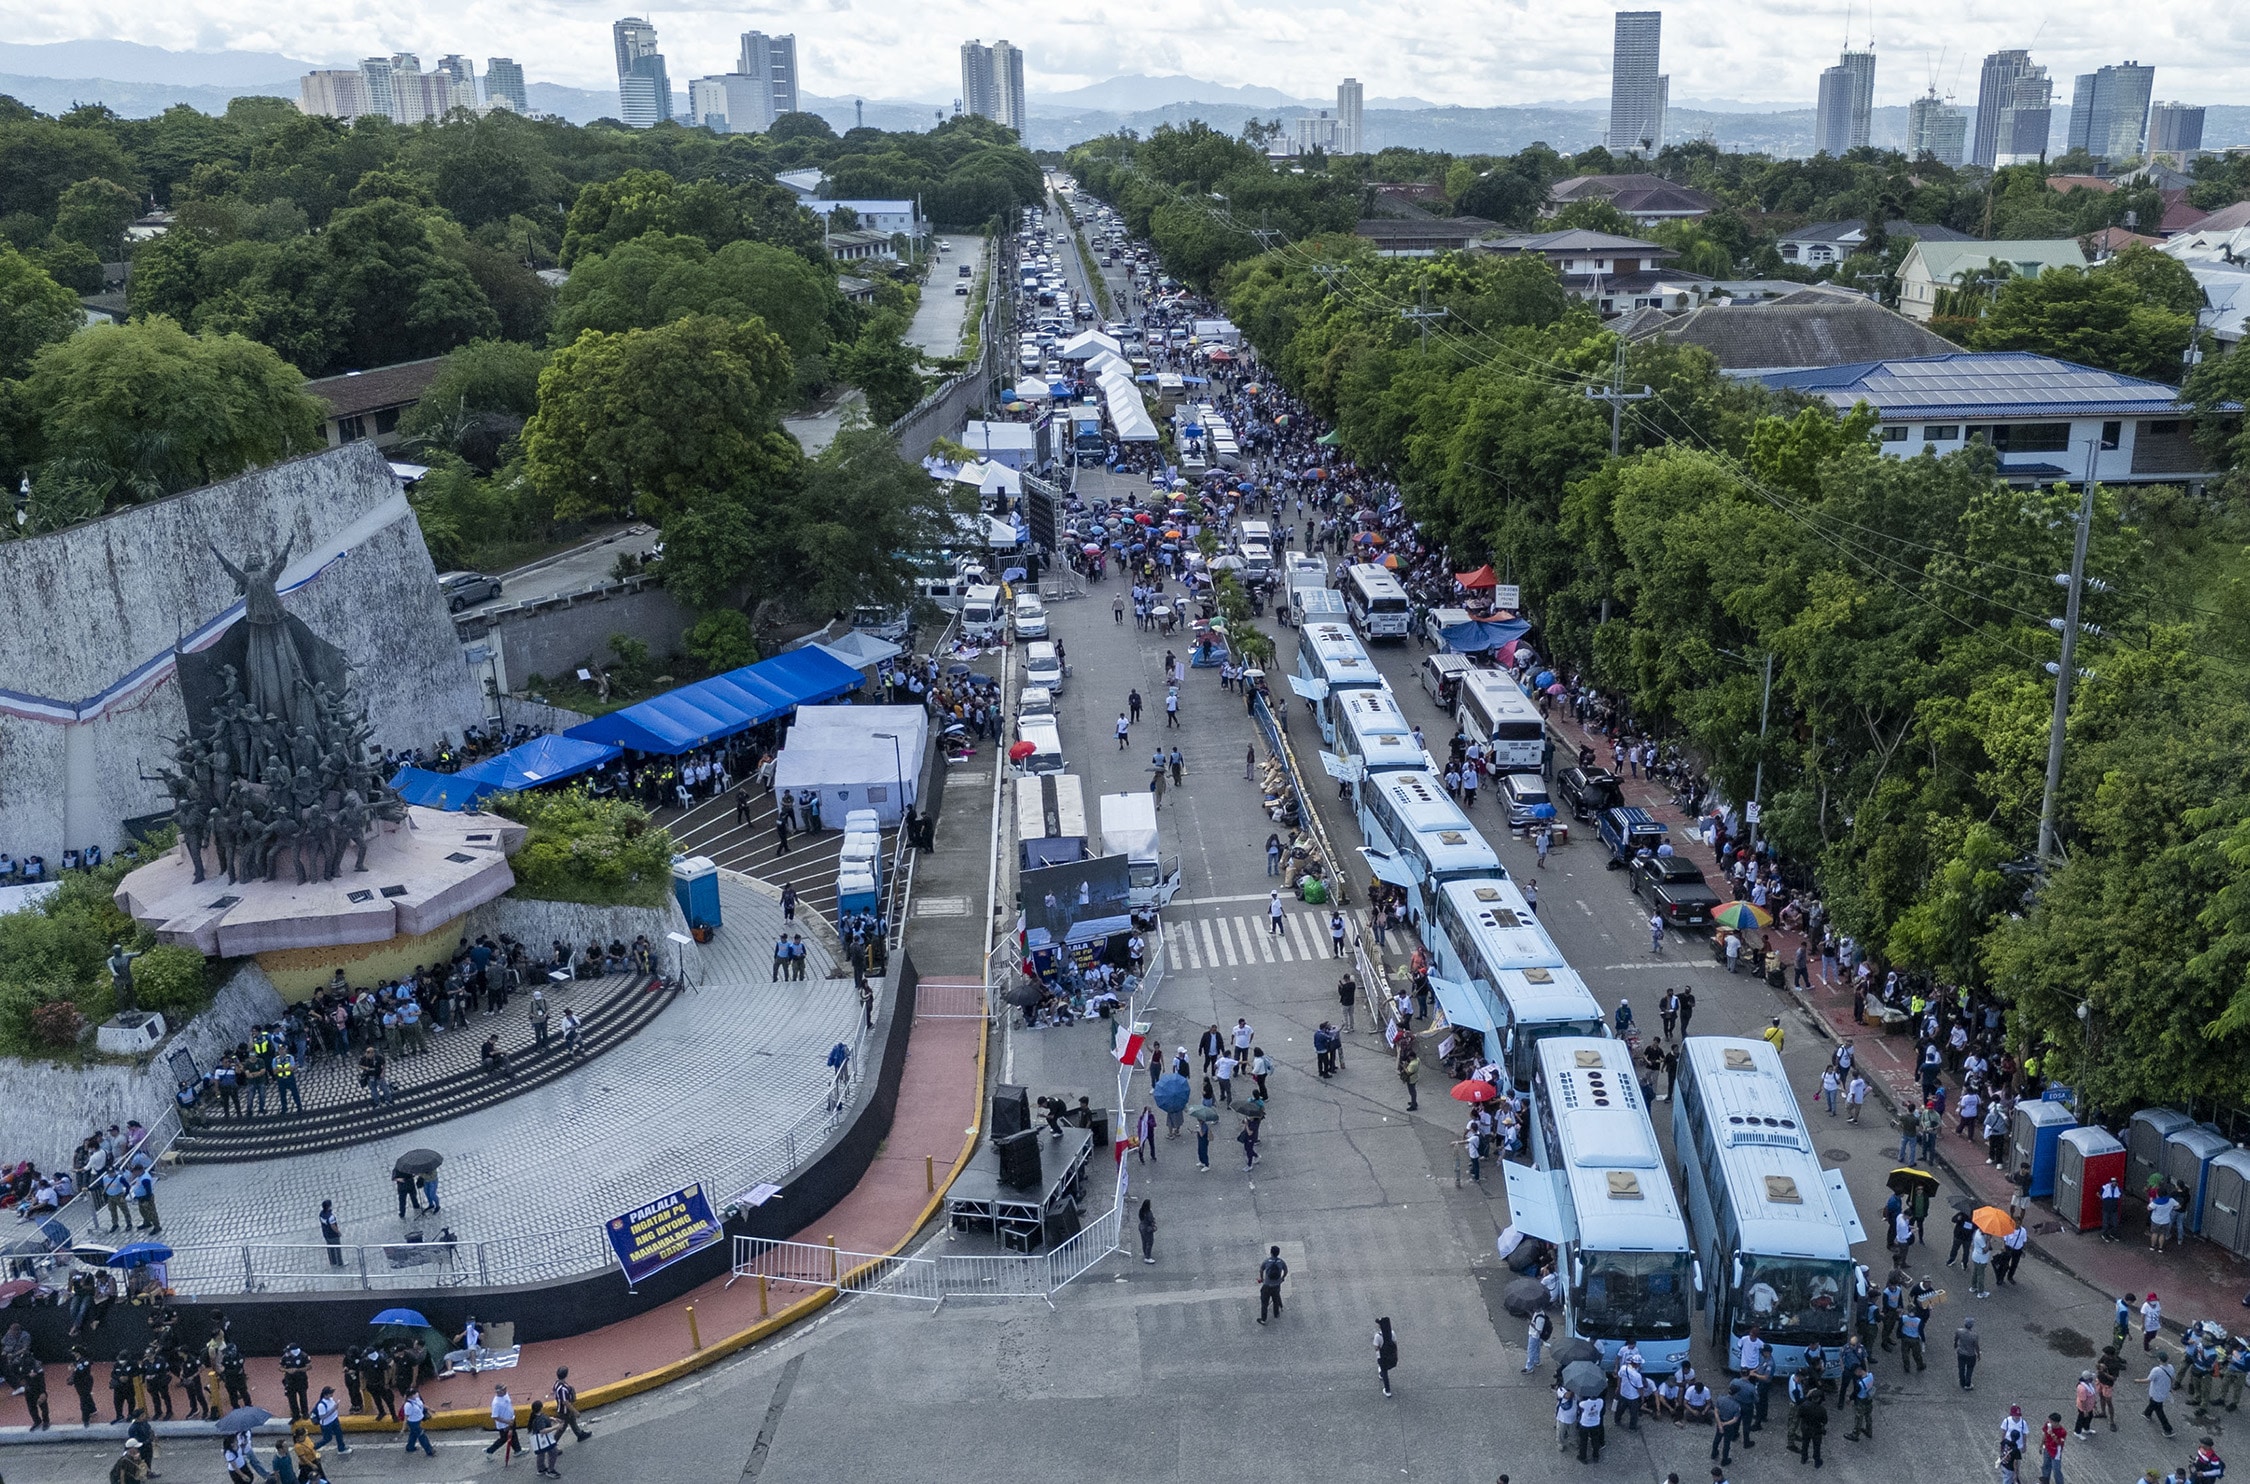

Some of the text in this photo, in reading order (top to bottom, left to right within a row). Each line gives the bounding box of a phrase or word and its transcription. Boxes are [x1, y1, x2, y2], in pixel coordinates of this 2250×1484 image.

[629, 1195, 679, 1224] PAALALA
[630, 1203, 687, 1235] INGATAN PO
[629, 1219, 708, 1262] MAHAHALAGANG
[635, 1214, 692, 1247] ANG INYONG
